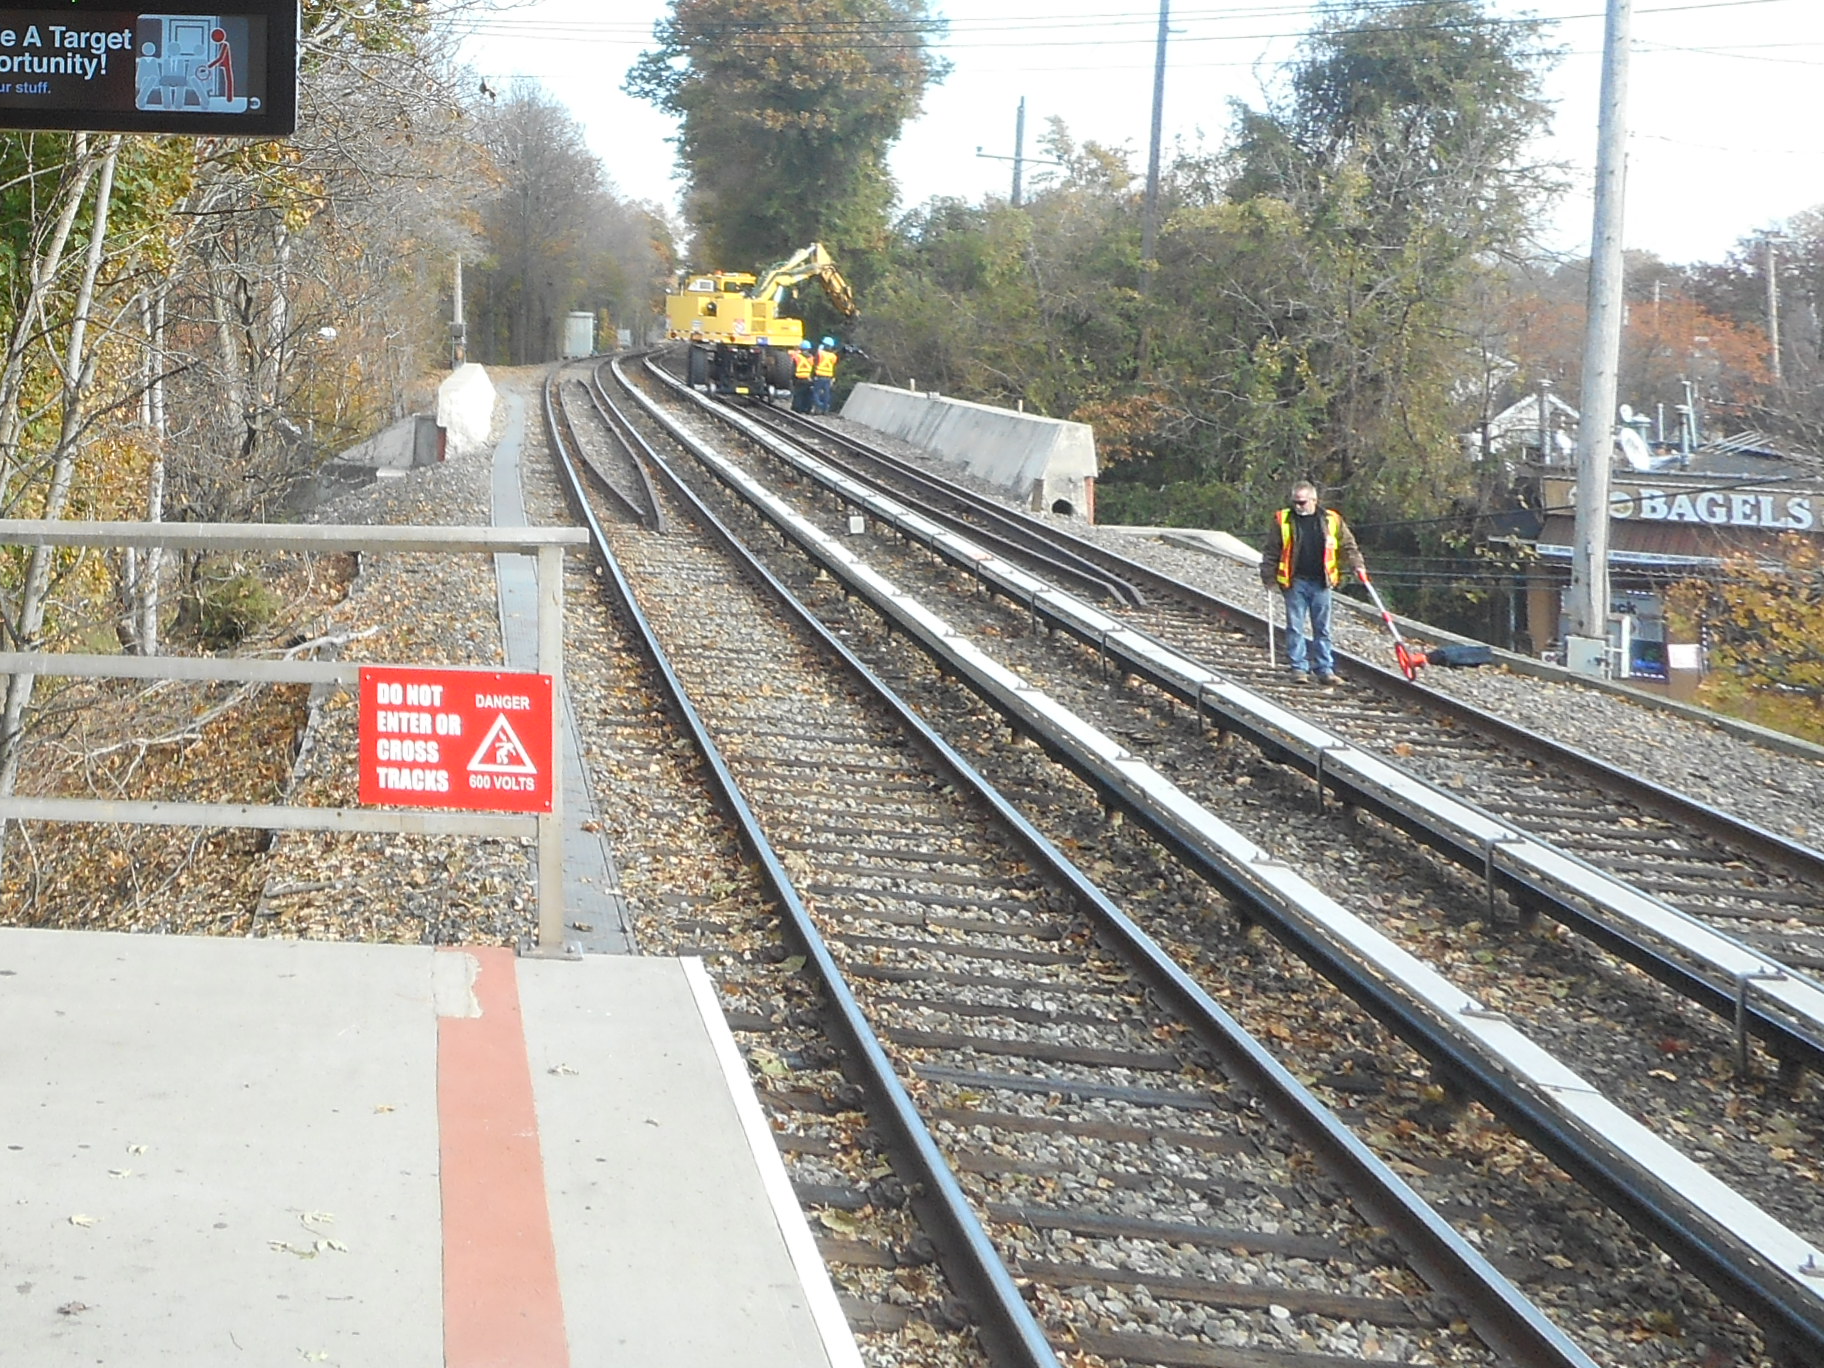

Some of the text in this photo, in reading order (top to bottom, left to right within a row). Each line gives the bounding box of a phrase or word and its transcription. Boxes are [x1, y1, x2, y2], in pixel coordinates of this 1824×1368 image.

[23, 26, 42, 47] A
[49, 26, 132, 54] Target
[15, 81, 51, 94] stuff.
[1638, 488, 1813, 530] BAGELS
[377, 683, 443, 706] DO NOT
[476, 694, 530, 710] DANGER
[377, 710, 461, 736] ENTER OR
[377, 738, 440, 763] CROSS
[376, 767, 449, 792] TRACKS
[469, 775, 535, 791] 600 VOLTS
